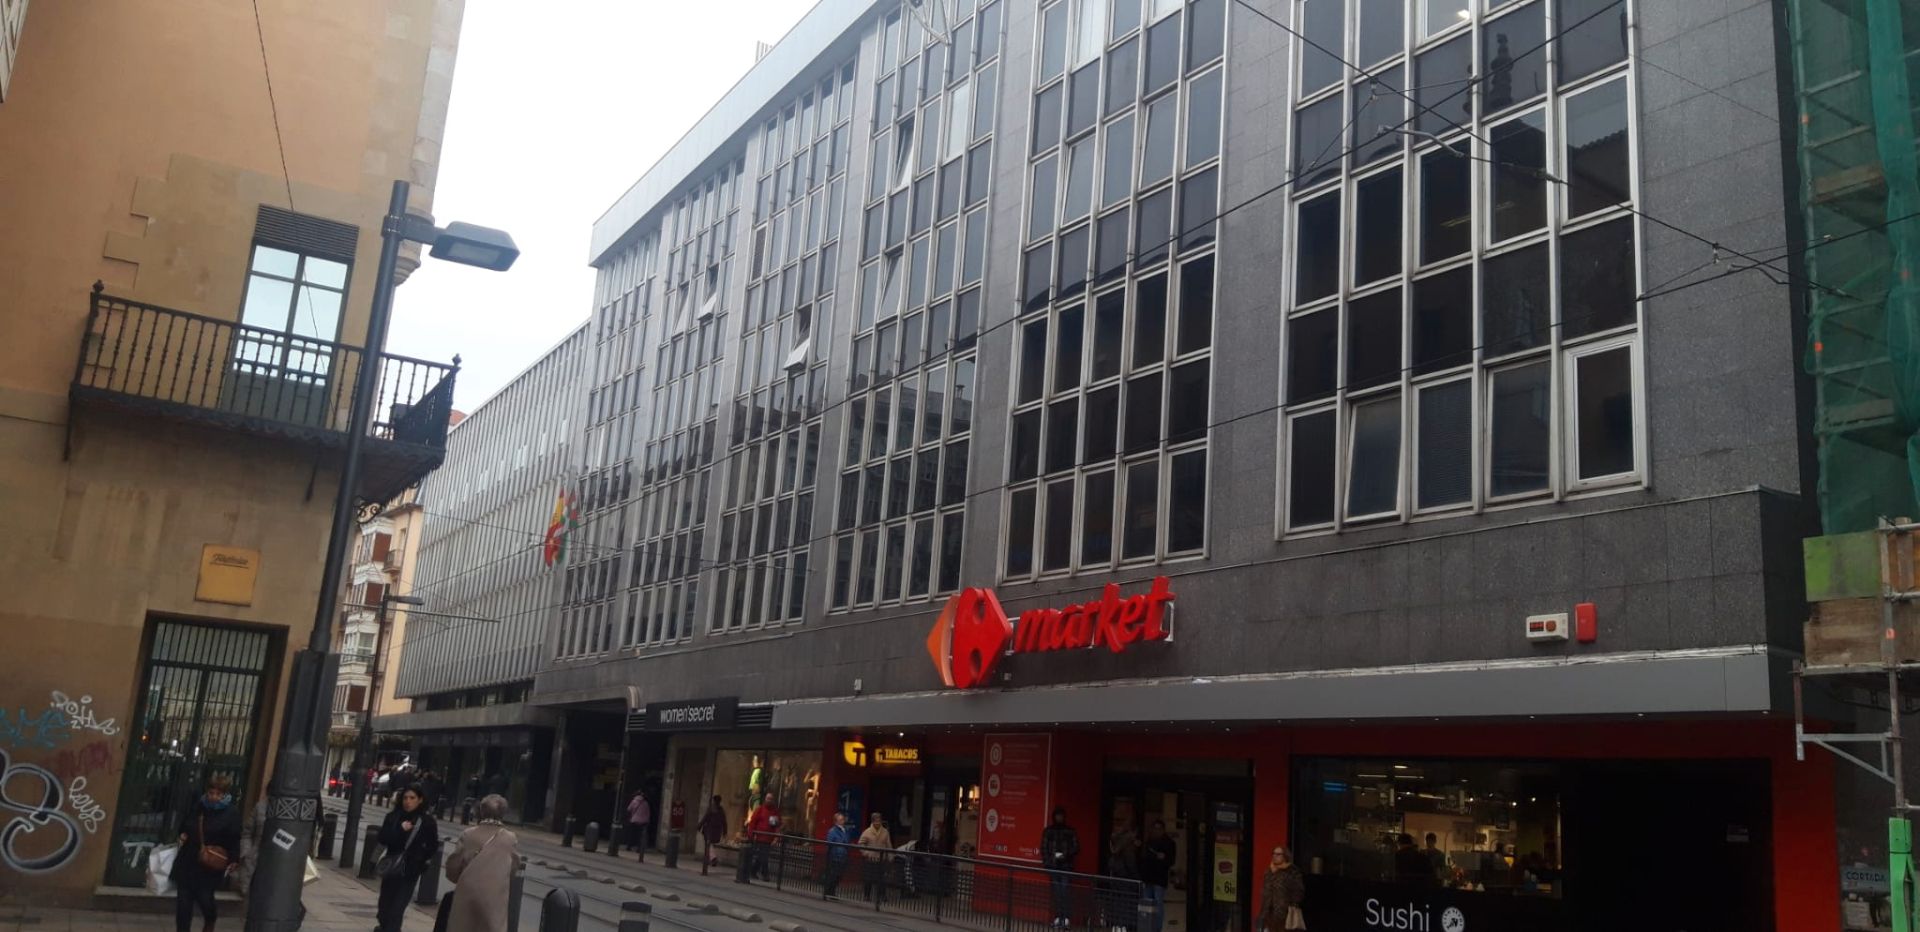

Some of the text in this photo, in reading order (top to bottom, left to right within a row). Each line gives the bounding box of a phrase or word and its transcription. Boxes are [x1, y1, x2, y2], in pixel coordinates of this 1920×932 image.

[1015, 576, 1177, 653] market
[660, 703, 716, 723] women'secret
[885, 748, 918, 760] TABACOS
[1366, 898, 1430, 932] Sushi
